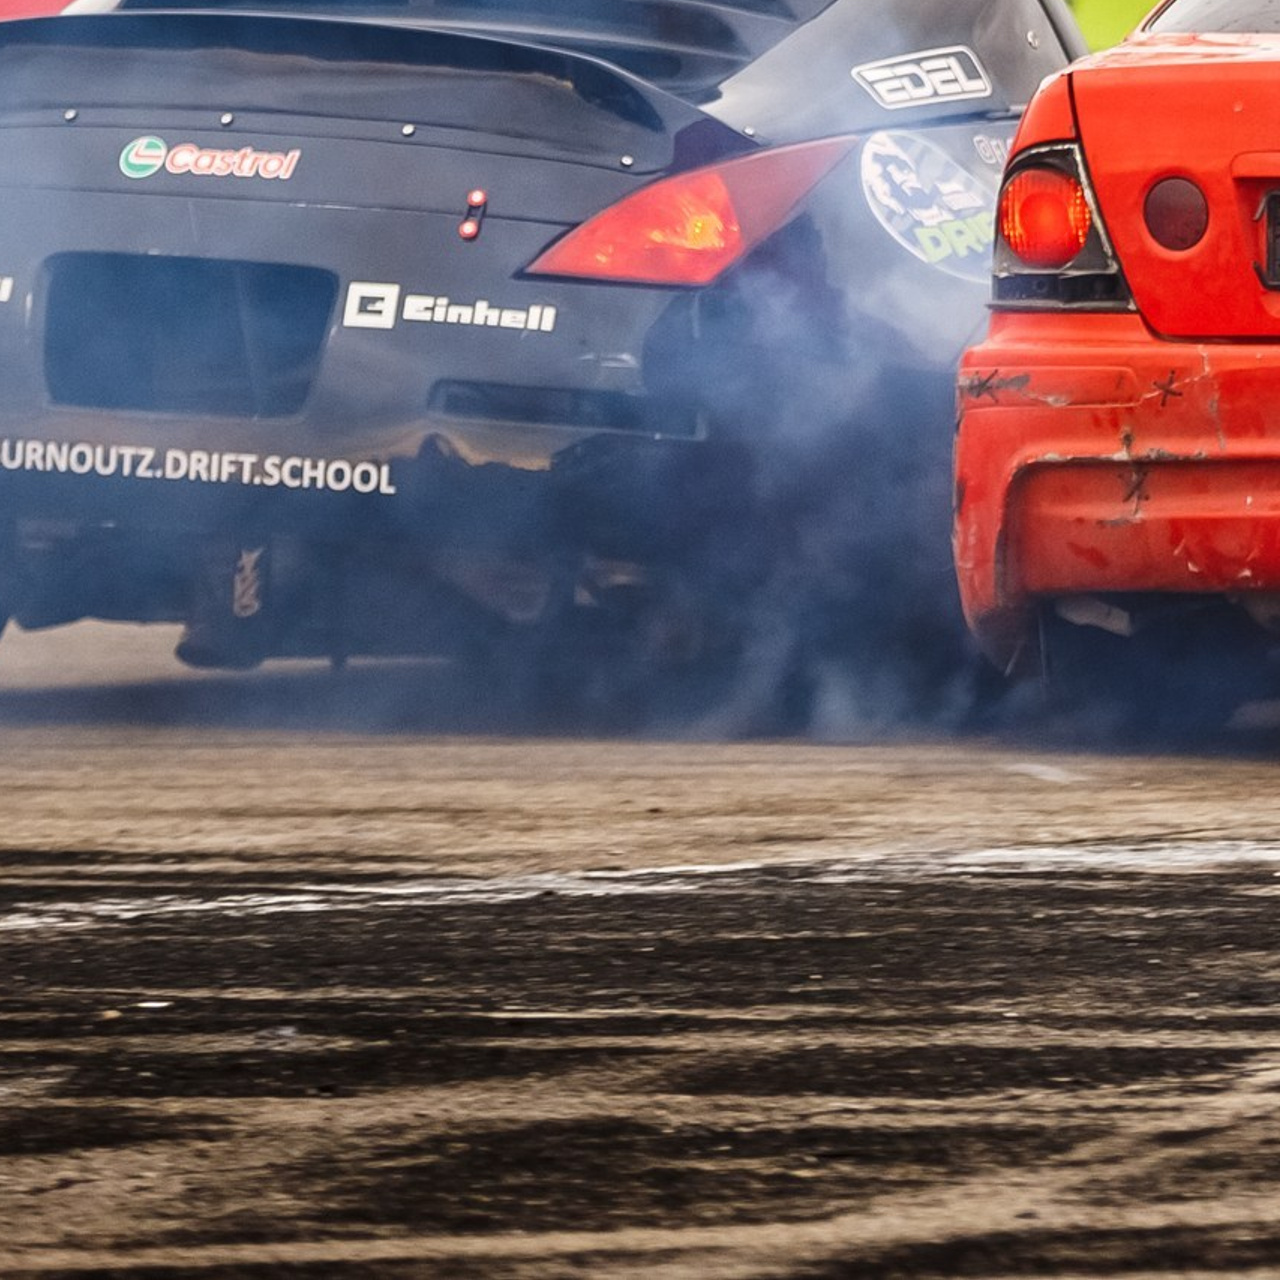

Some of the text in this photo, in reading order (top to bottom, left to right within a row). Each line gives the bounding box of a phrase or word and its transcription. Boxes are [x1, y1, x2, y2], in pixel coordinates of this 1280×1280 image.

[859, 56, 986, 104] EDEL
[165, 143, 301, 179] Castrol
[402, 294, 556, 332] Einhell
